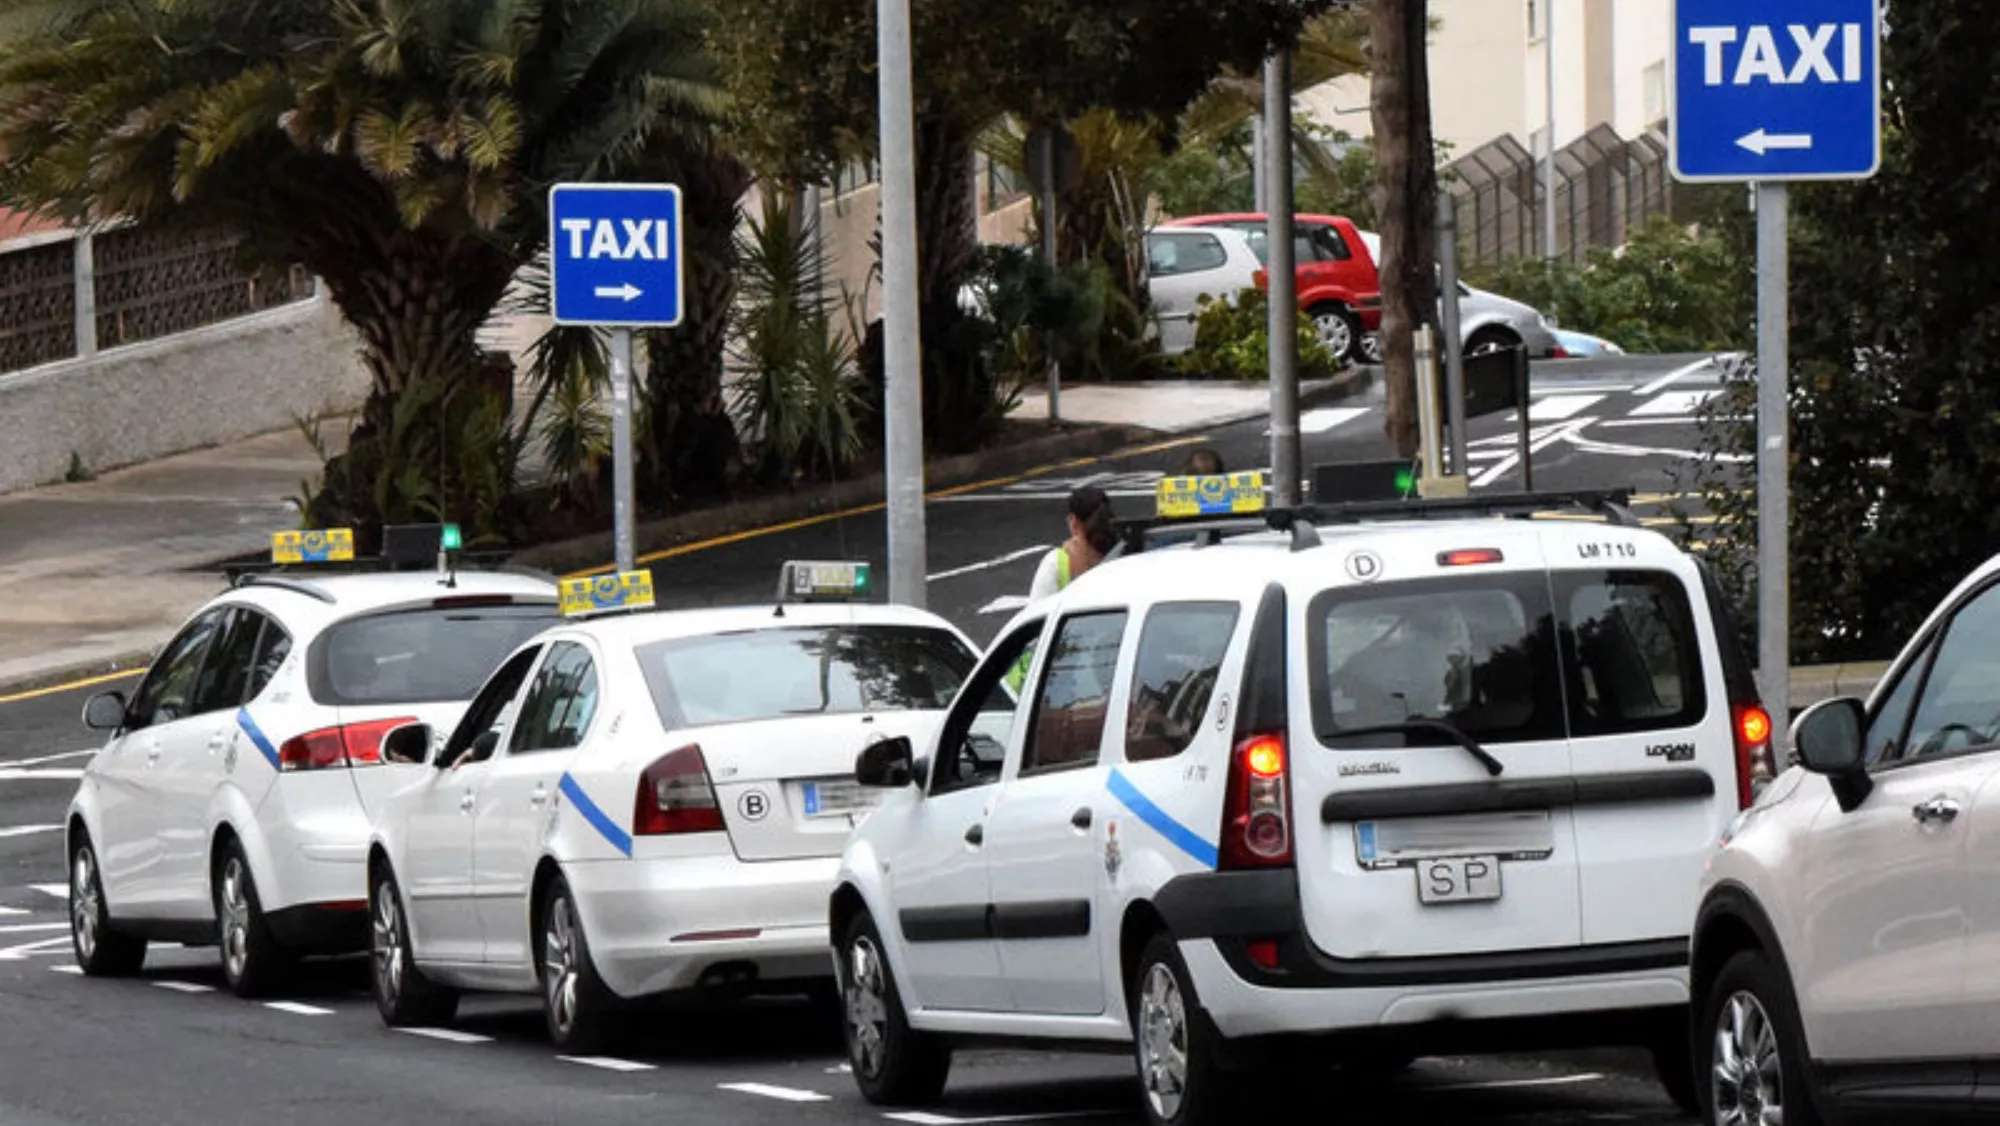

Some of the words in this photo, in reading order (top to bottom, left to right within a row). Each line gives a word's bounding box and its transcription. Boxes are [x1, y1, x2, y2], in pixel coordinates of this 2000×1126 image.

[1689, 23, 1861, 86] TAXI
[560, 218, 668, 260] TAXI
[1429, 861, 1489, 896] SP
